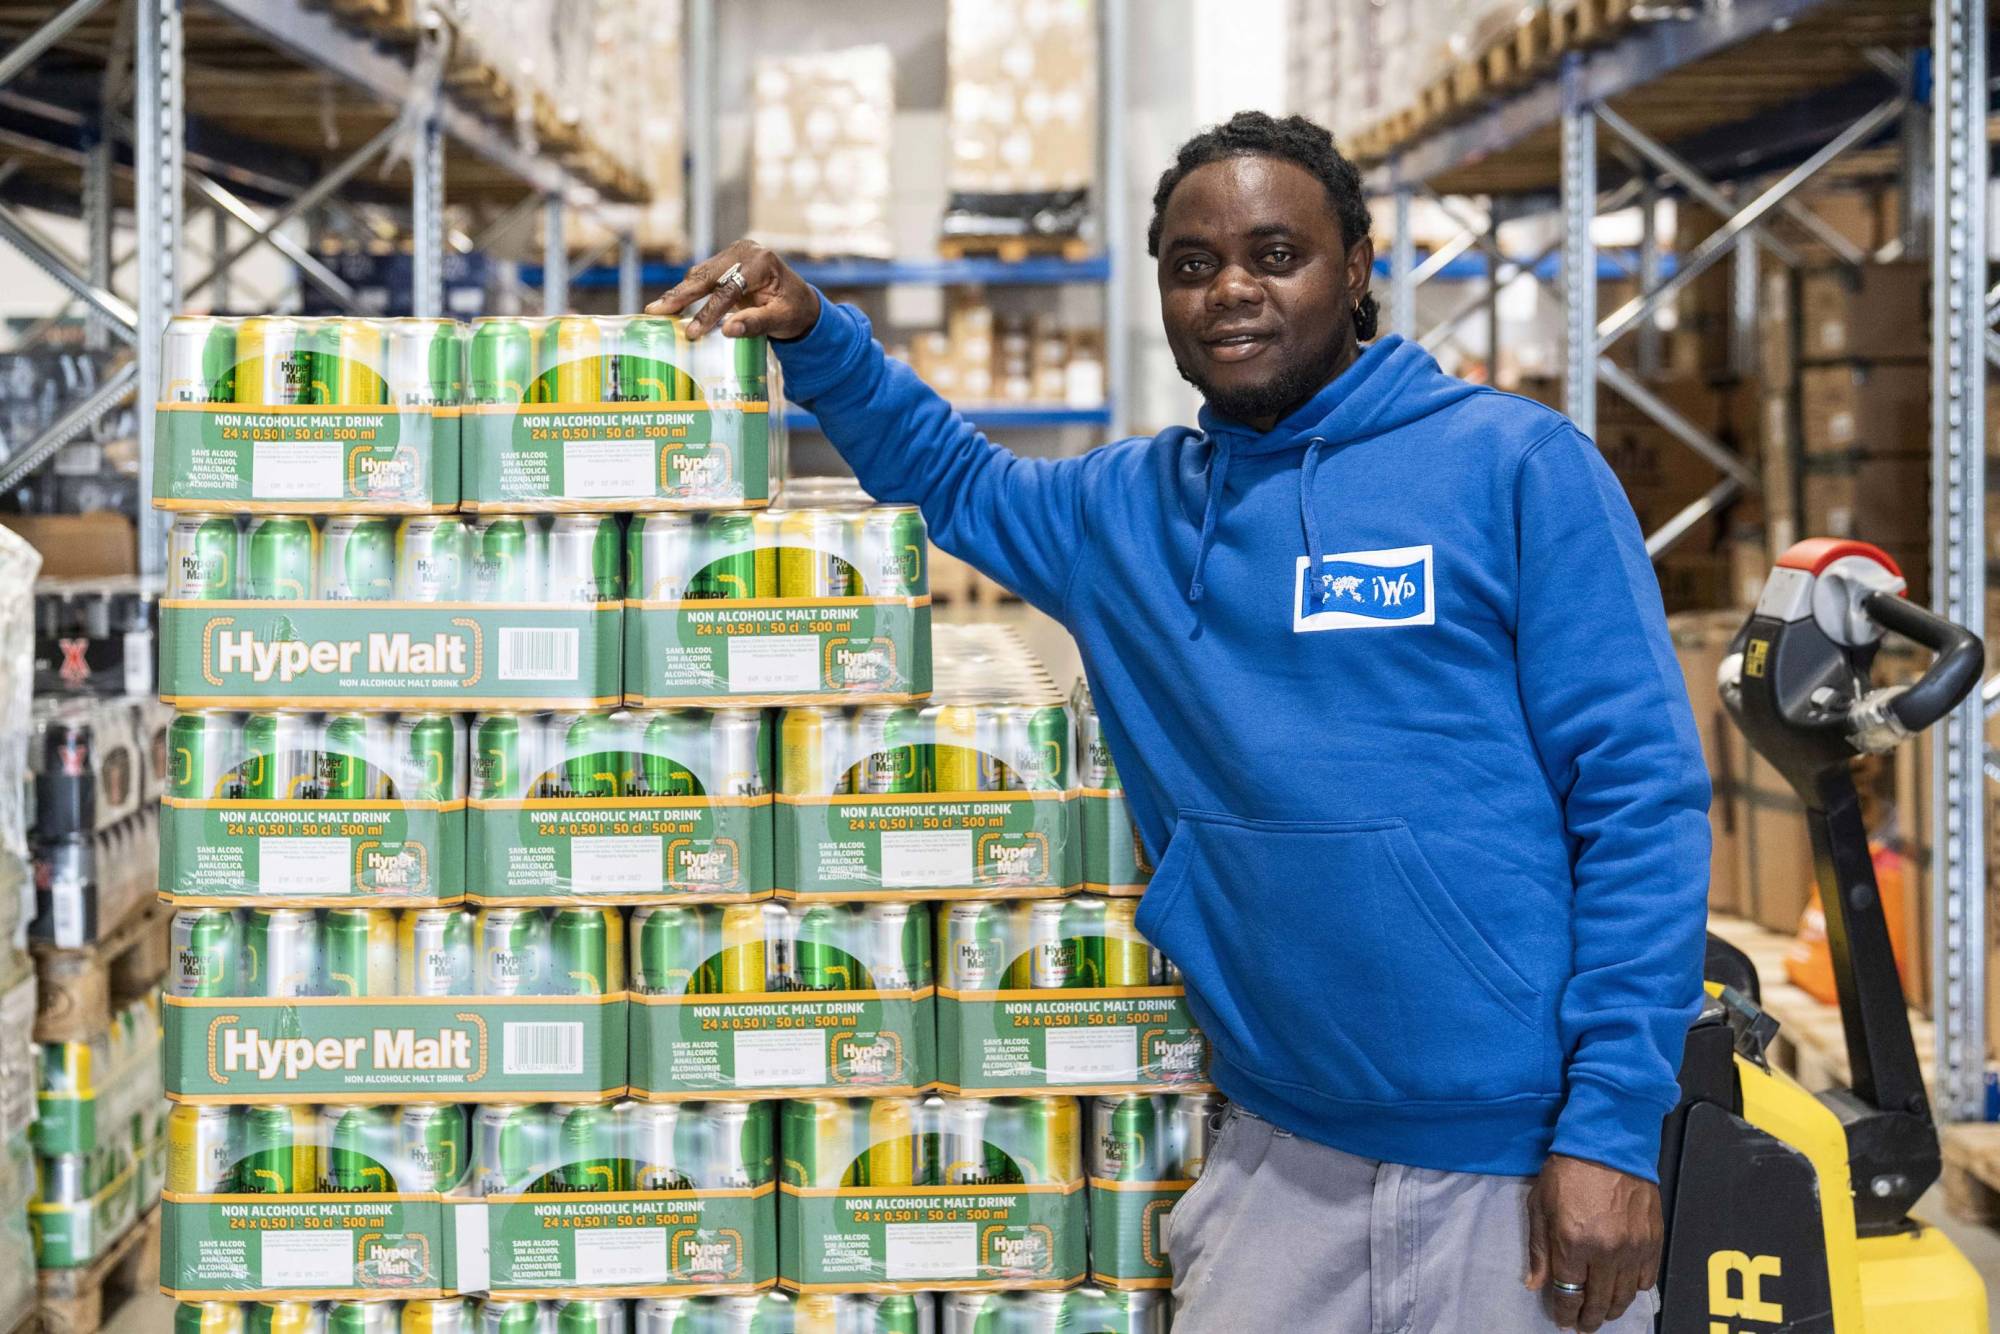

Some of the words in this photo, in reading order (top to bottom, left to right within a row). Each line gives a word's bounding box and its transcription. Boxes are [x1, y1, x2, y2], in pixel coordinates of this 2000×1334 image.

[282, 362, 310, 375] Hyper
[215, 416, 241, 426] NON
[244, 415, 308, 427] ALCOHOLIC
[312, 416, 342, 427] MALT
[346, 416, 383, 427] DRINK
[524, 416, 550, 428] NON
[553, 414, 619, 427] ALCOHOLIC
[622, 414, 653, 425] MALT
[656, 413, 694, 425] DRINK
[223, 428, 238, 440] 24
[241, 430, 249, 439] x
[252, 428, 279, 441] 0,50
[296, 428, 311, 440] 50
[314, 428, 324, 440] cl
[334, 429, 357, 440] 500
[360, 428, 375, 440] ml
[501, 452, 520, 460] SANS
[521, 451, 548, 459] ALCOOL
[502, 460, 515, 468] SIN
[517, 459, 548, 467] ALCOHOL
[182, 557, 216, 572] Hyper
[186, 569, 212, 580] Malt
[689, 612, 715, 623] NON
[718, 609, 783, 622] ALCOHOLIC
[787, 609, 817, 620] MALT
[821, 608, 858, 620] DRINK
[219, 630, 361, 683] Hyper
[368, 632, 467, 674] Malt
[666, 647, 685, 655] SANS
[686, 646, 713, 655] ALCOOL
[667, 655, 680, 663] SIN
[681, 654, 712, 663] ALCOHOL
[339, 679, 358, 687] NON
[360, 679, 406, 687] ALCOHOLIC
[408, 679, 430, 687] MALT
[432, 679, 458, 687] DRINK
[221, 812, 247, 822] NON
[250, 811, 315, 823] ALCOHOLIC
[319, 811, 349, 823] MALT
[353, 811, 390, 823] DRINK
[532, 812, 558, 823] NON
[561, 810, 626, 822] ALCOHOLIC
[630, 810, 660, 821] MALT
[664, 809, 701, 821] DRINK
[842, 807, 868, 818] NON
[871, 805, 936, 817] ALCOHOLIC
[939, 804, 970, 816] MALT
[973, 803, 1011, 815] DRINK
[228, 824, 244, 836] 24
[247, 827, 255, 836] x
[258, 824, 286, 837] 0,50
[302, 824, 318, 836] 50
[321, 824, 331, 836] cl
[341, 824, 365, 836] 500
[368, 824, 383, 836] ml
[849, 819, 865, 831] 24
[868, 821, 876, 830] x
[880, 818, 907, 832] 0,50
[923, 817, 939, 829] 50
[942, 817, 952, 829] cl
[962, 816, 986, 828] 500
[989, 815, 1004, 827] ml
[680, 849, 727, 868] Hyper
[990, 843, 1037, 861] Hyper
[1045, 944, 1077, 959] Hyper
[179, 952, 211, 966] Hyper
[1051, 955, 1075, 967] Malt
[183, 965, 207, 976] Malt
[695, 1006, 721, 1018] NON
[723, 1004, 789, 1017] ALCOHOLIC
[792, 1003, 823, 1015] MALT
[826, 1002, 864, 1014] DRINK
[1007, 1003, 1032, 1014] NON
[1035, 1001, 1101, 1014] ALCOHOLIC
[1104, 1000, 1135, 1012] MALT
[1138, 999, 1175, 1011] DRINK
[1014, 1016, 1030, 1027] 24
[1033, 1017, 1041, 1027] x
[1044, 1014, 1071, 1028] 0,50
[1088, 1014, 1104, 1025] 50
[1107, 1013, 1117, 1025] cl
[1126, 1012, 1150, 1024] 500
[1153, 1011, 1168, 1024] ml
[672, 1042, 691, 1050] SANS
[692, 1041, 719, 1049] ALCOOL
[843, 1042, 891, 1061] Hyper
[223, 1028, 366, 1080] Hyper
[372, 1029, 472, 1070] Malt
[673, 1050, 686, 1058] SIN
[687, 1049, 718, 1057] ALCOHOL
[1105, 1149, 1128, 1161] Malt
[223, 1206, 249, 1217] NON
[251, 1204, 317, 1216] ALCOHOLIC
[320, 1204, 351, 1215] MALT
[355, 1203, 392, 1215] DRINK
[535, 1205, 562, 1216] NON
[564, 1202, 630, 1215] ALCOHOLIC
[633, 1201, 664, 1213] MALT
[667, 1200, 705, 1212] DRINK
[847, 1199, 873, 1210] NON
[876, 1197, 941, 1210] ALCOHOLIC
[944, 1196, 975, 1208] MALT
[978, 1196, 1015, 1207] DRINK
[854, 1211, 870, 1223] 24
[873, 1213, 881, 1222] x
[885, 1211, 912, 1224] 0,50
[928, 1210, 944, 1222] 50
[947, 1209, 957, 1221] cl
[967, 1209, 990, 1221] 500
[993, 1208, 1008, 1220] ml
[230, 1218, 246, 1230] 24
[249, 1220, 257, 1229] x
[260, 1218, 288, 1231] 0,50
[304, 1217, 320, 1229] 50
[323, 1217, 333, 1229] cl
[343, 1217, 367, 1228] 500
[370, 1216, 385, 1228] ml
[513, 1240, 532, 1248] SANS
[533, 1239, 560, 1247] ALCOOL
[684, 1240, 732, 1258] Hyper
[370, 1244, 418, 1262] Hyper
[514, 1248, 527, 1256] SIN
[528, 1247, 559, 1255] ALCOHOL
